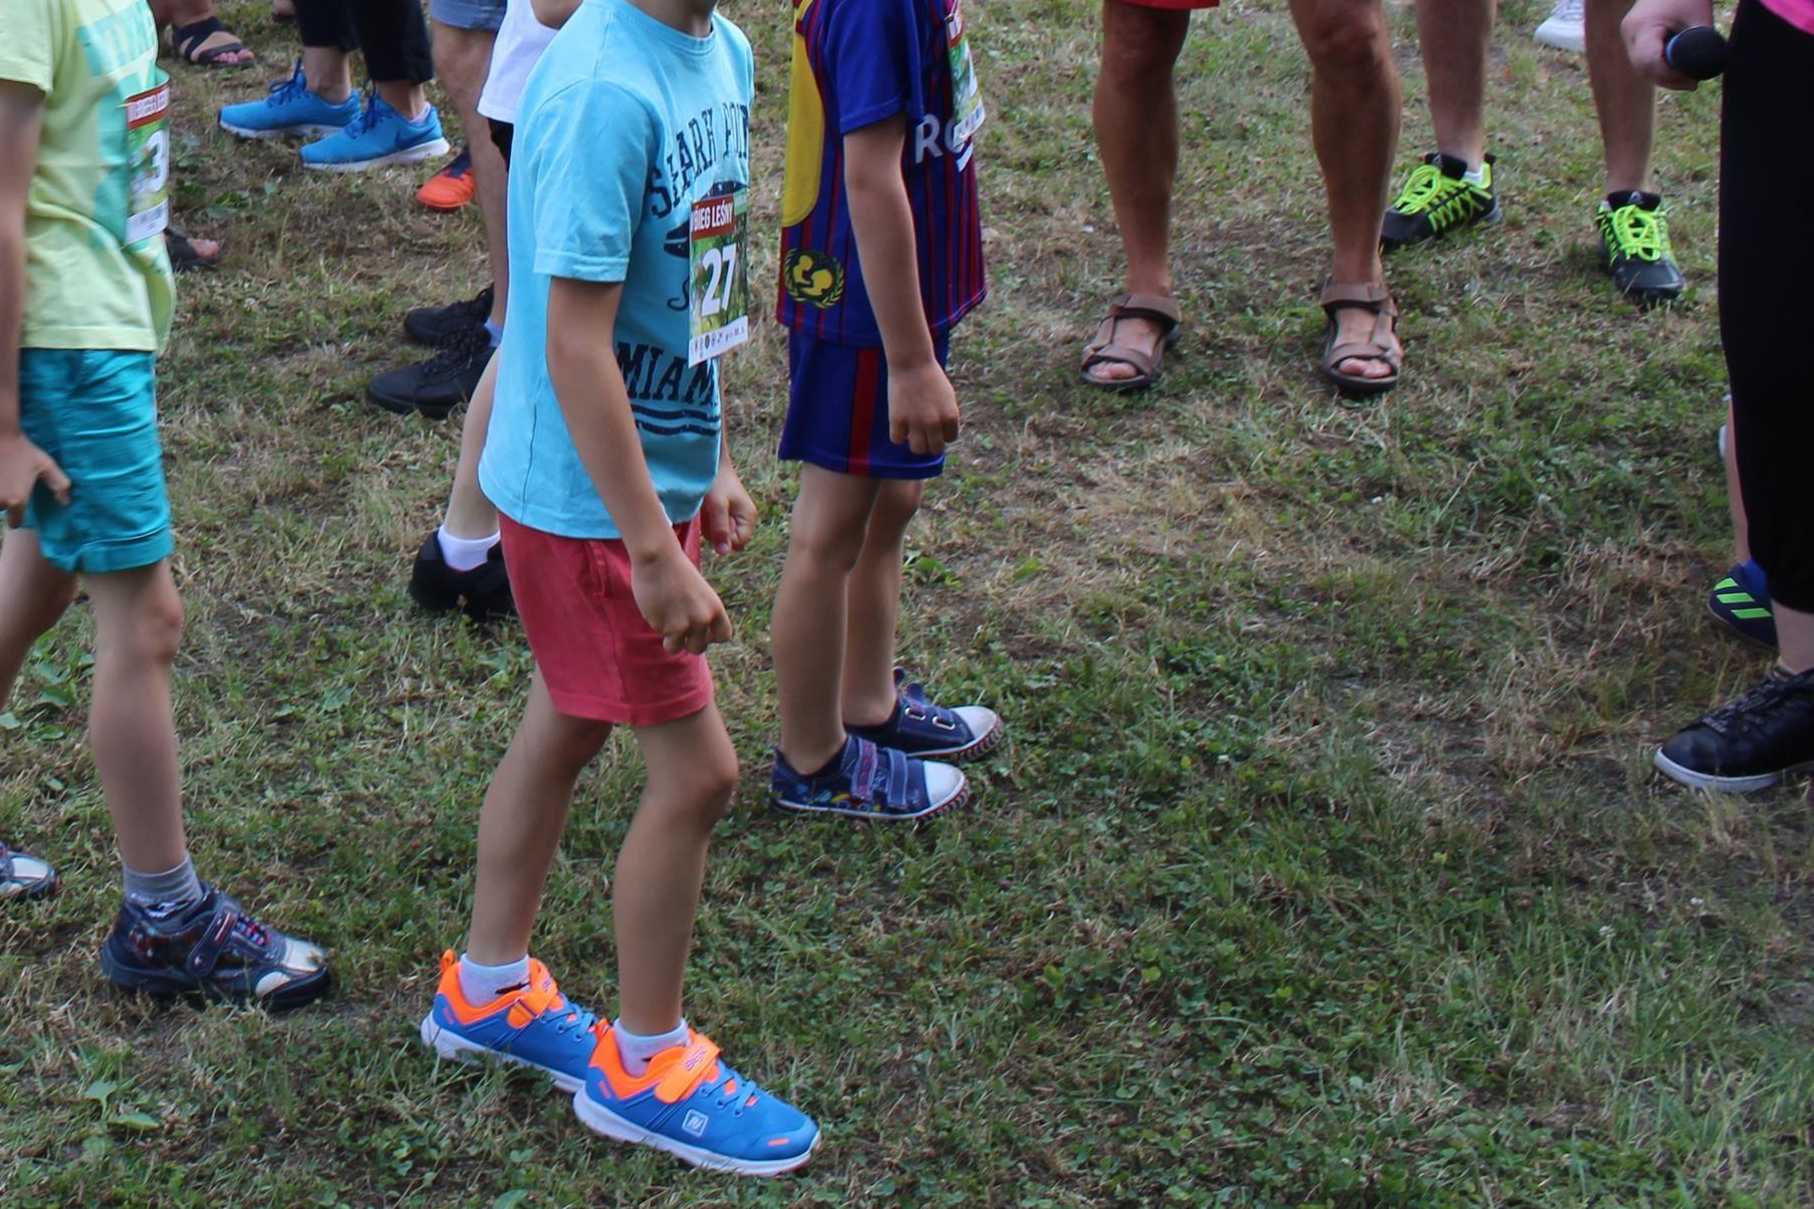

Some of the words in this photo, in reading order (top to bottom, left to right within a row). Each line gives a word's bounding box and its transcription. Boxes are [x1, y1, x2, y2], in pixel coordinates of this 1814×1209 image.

[650, 104, 715, 219] SHARK
[711, 199, 733, 228] LEŚNY
[701, 243, 735, 317] 27
